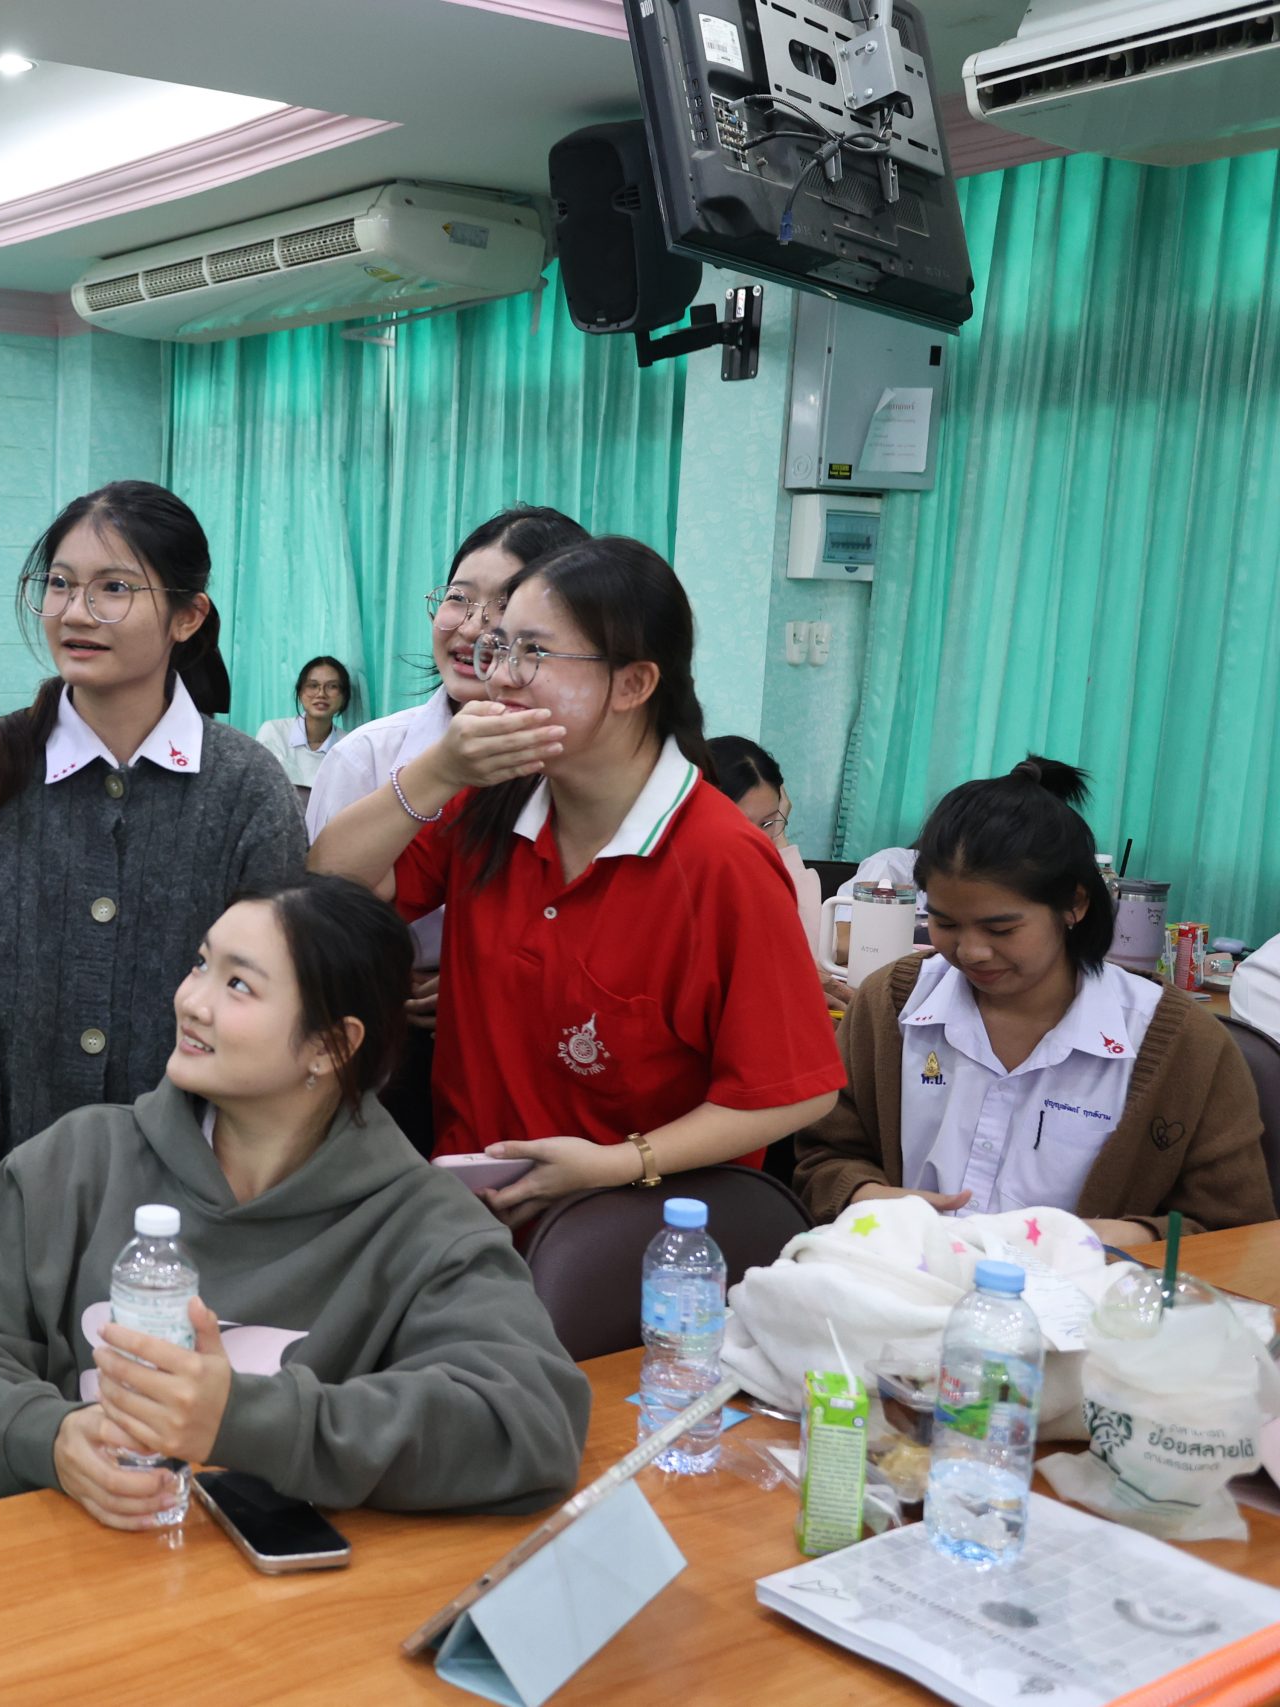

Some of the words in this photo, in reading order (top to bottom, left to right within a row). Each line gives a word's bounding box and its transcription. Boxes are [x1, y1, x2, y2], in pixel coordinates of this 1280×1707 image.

[1147, 1428, 1254, 1459] ย่อยสลายได้
